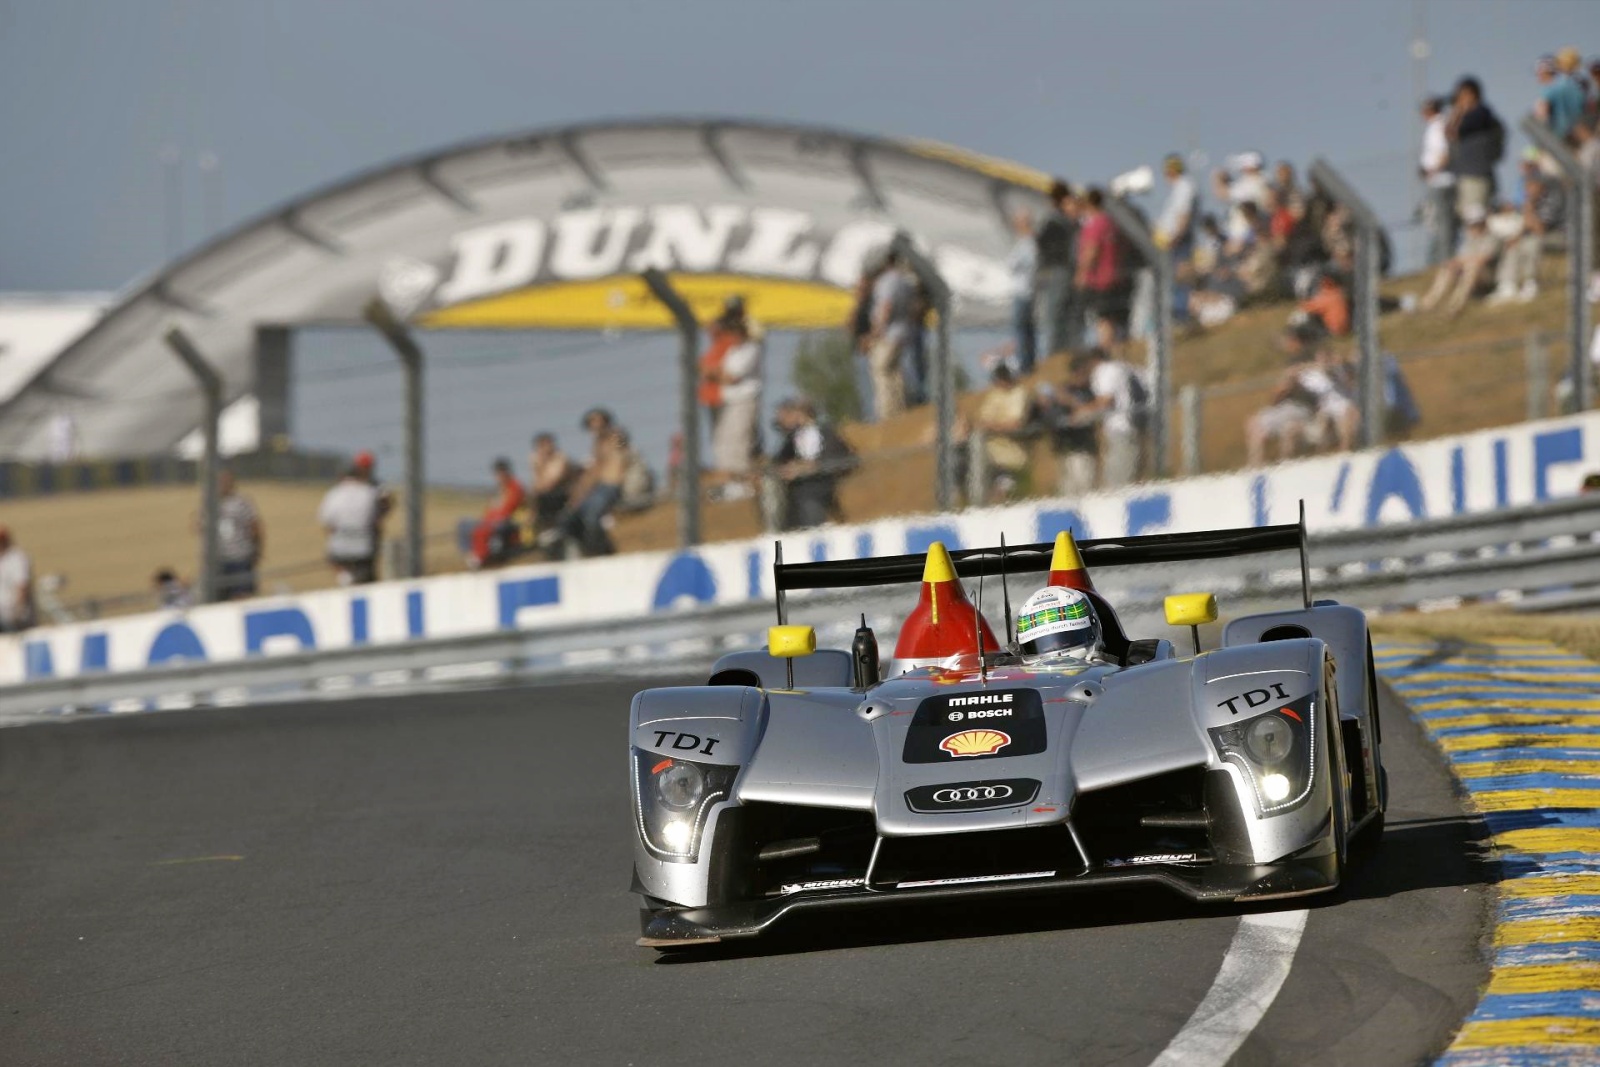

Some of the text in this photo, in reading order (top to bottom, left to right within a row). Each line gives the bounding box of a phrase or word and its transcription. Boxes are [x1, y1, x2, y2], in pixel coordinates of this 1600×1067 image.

[948, 694, 1013, 707] MAHLE
[1217, 682, 1290, 715] TDI
[967, 708, 1013, 719] BOSCH
[653, 730, 720, 756] TDI
